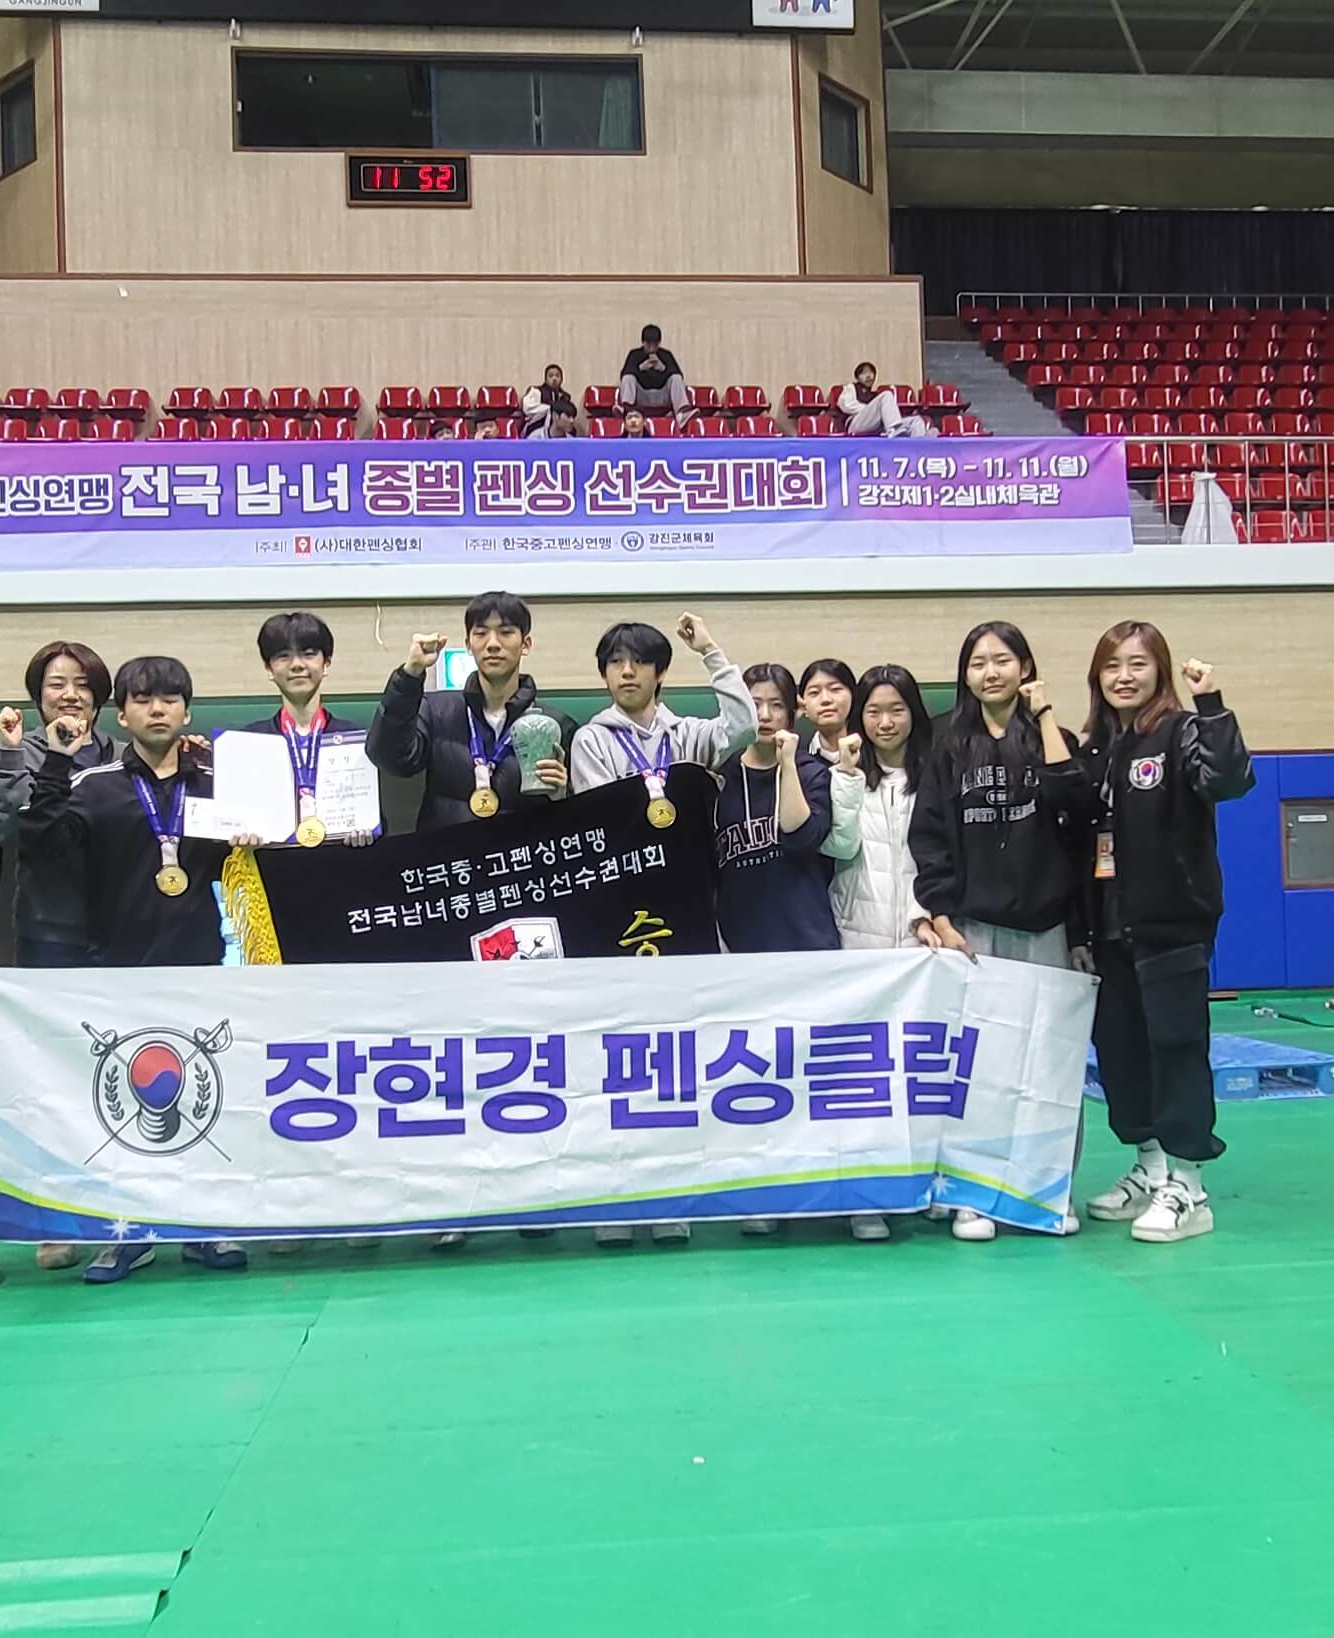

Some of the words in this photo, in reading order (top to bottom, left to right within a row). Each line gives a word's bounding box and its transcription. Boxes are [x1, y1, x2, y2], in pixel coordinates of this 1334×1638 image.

[418, 165, 453, 190] 52
[120, 464, 221, 517] 전국
[364, 460, 465, 516] 종별
[475, 460, 574, 515] 펜싱
[586, 457, 828, 514] 선수권대회
[314, 537, 422, 553] (사)대한펜싱협회
[502, 537, 612, 551] 한국중고펜싱연맹
[347, 843, 667, 933] 전국남녀종별펜싱선수권대회
[400, 827, 607, 894] 한국중·고펜싱연맹
[265, 1034, 568, 1142] 장현경
[601, 1020, 979, 1132] 펜싱클럽
